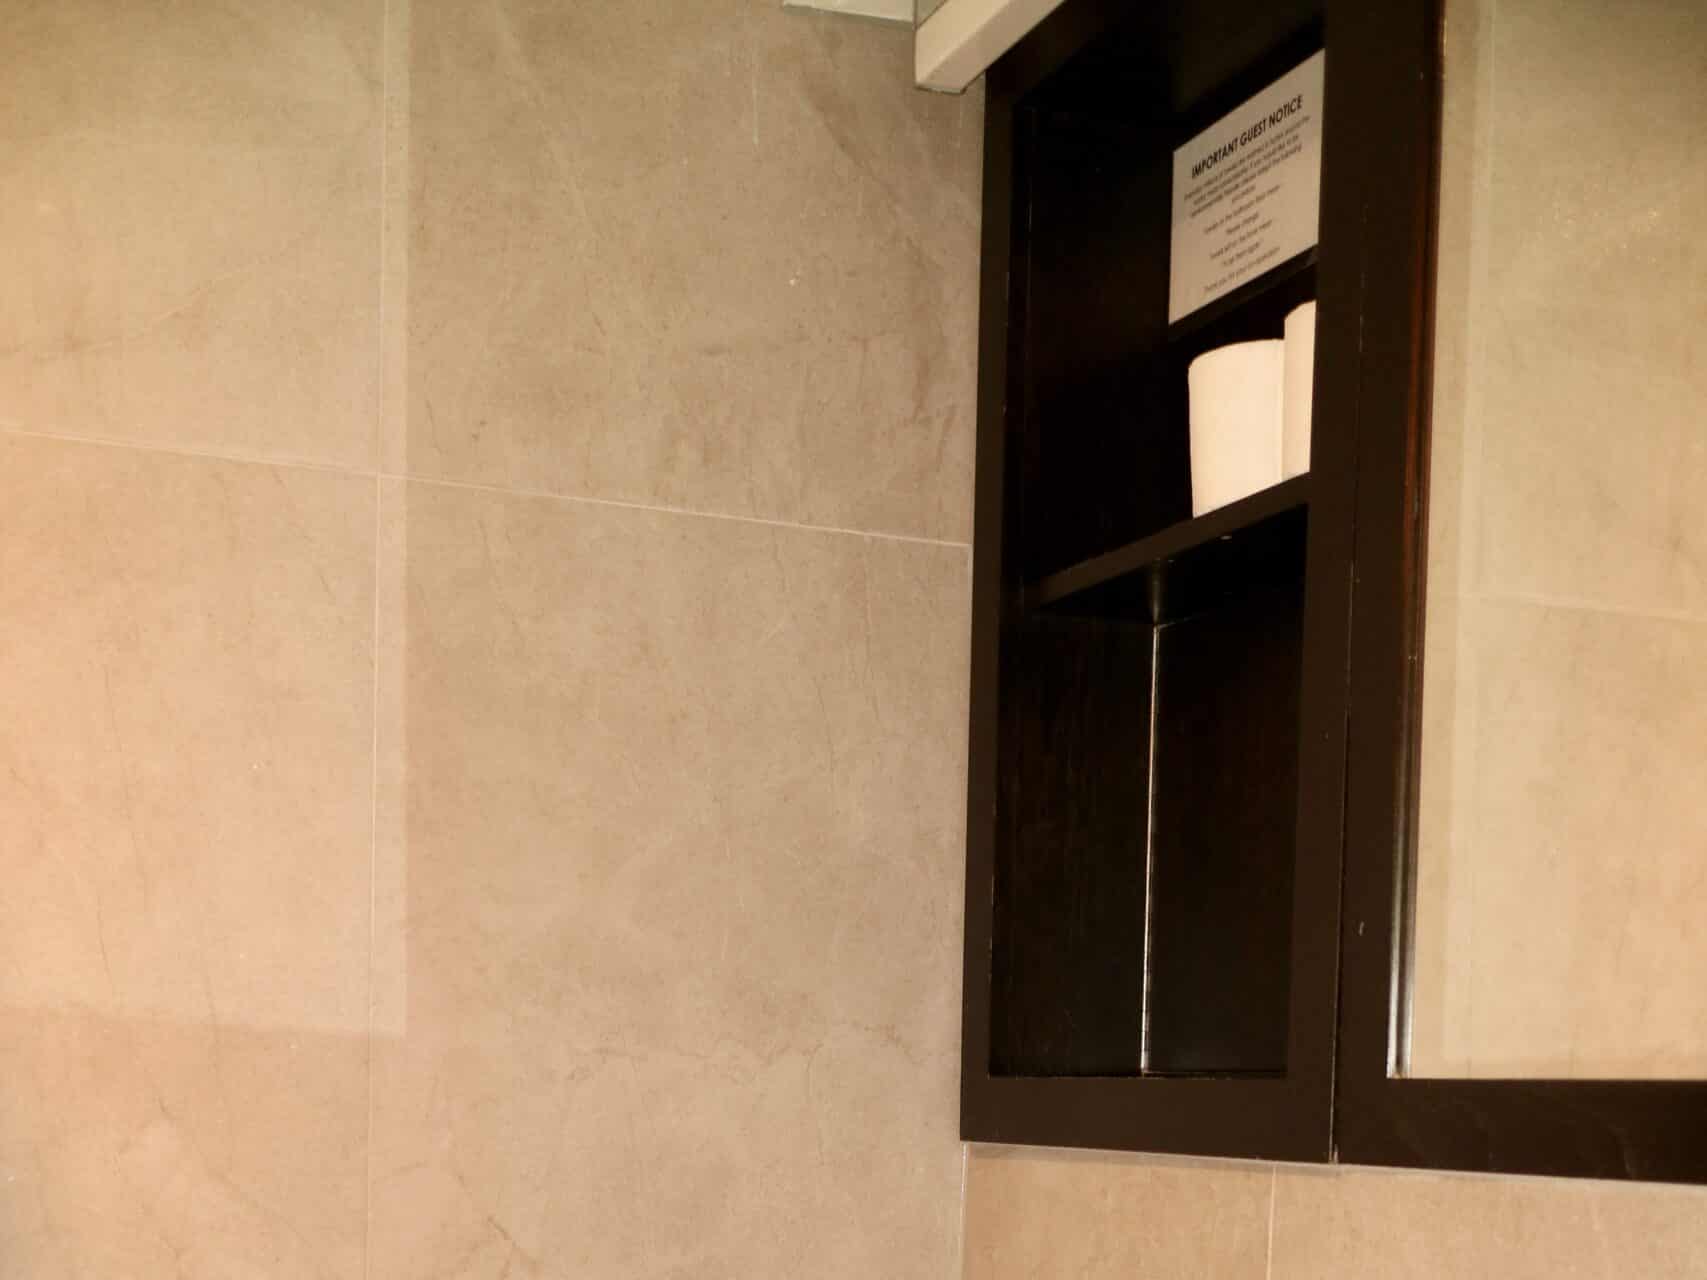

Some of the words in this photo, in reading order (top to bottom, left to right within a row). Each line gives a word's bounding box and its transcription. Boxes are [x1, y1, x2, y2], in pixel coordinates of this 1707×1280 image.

[1191, 136, 1238, 179] IMPORTANT
[1240, 119, 1266, 146] GUEST
[1269, 94, 1302, 128] NOTICE
